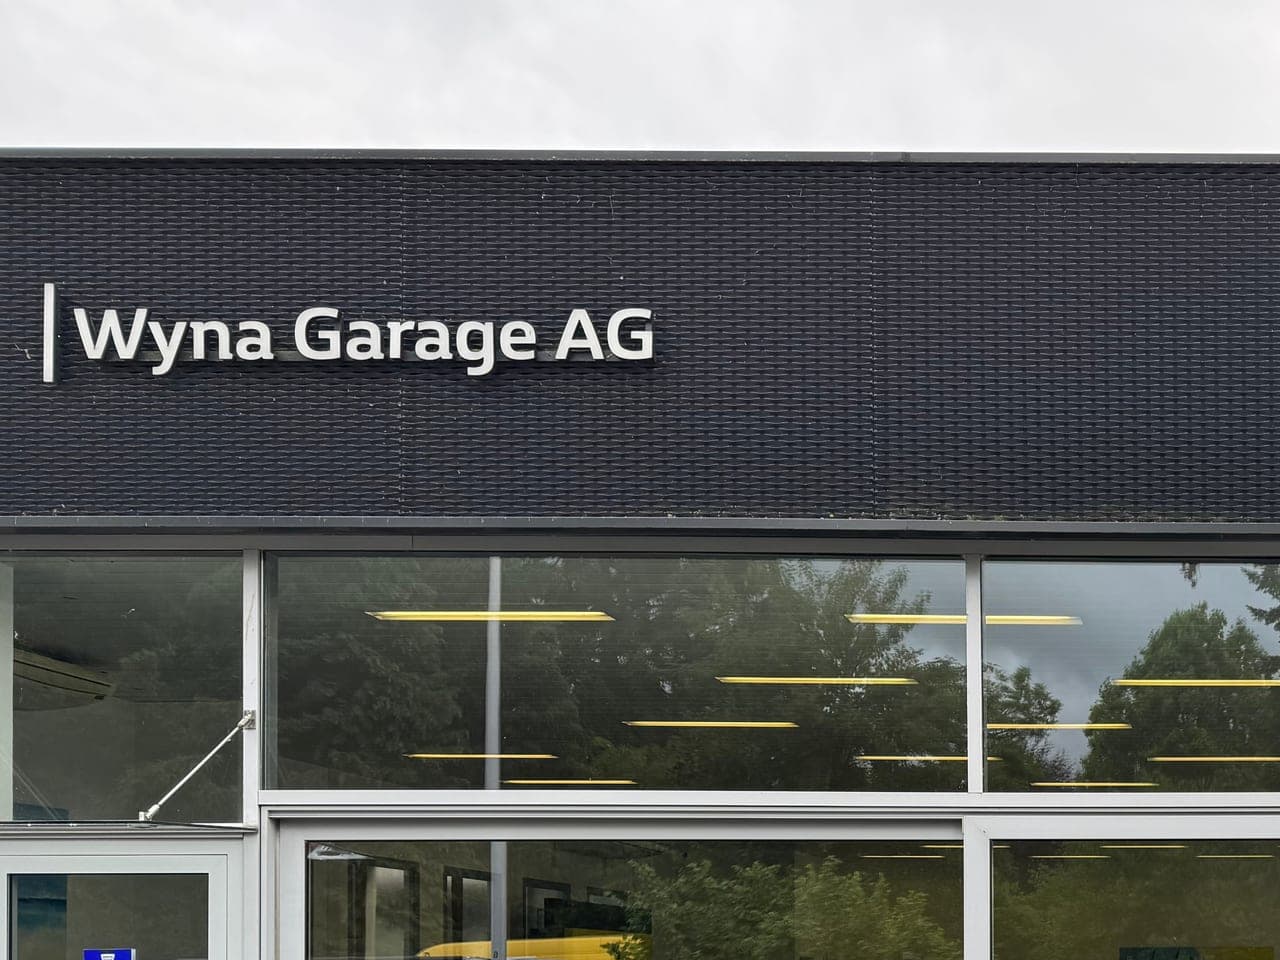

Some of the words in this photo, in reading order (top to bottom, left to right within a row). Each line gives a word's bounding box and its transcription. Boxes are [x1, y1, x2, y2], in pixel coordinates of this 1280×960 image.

[74, 308, 274, 376] Wyna
[294, 308, 536, 376] Garage
[555, 308, 654, 361] AG
